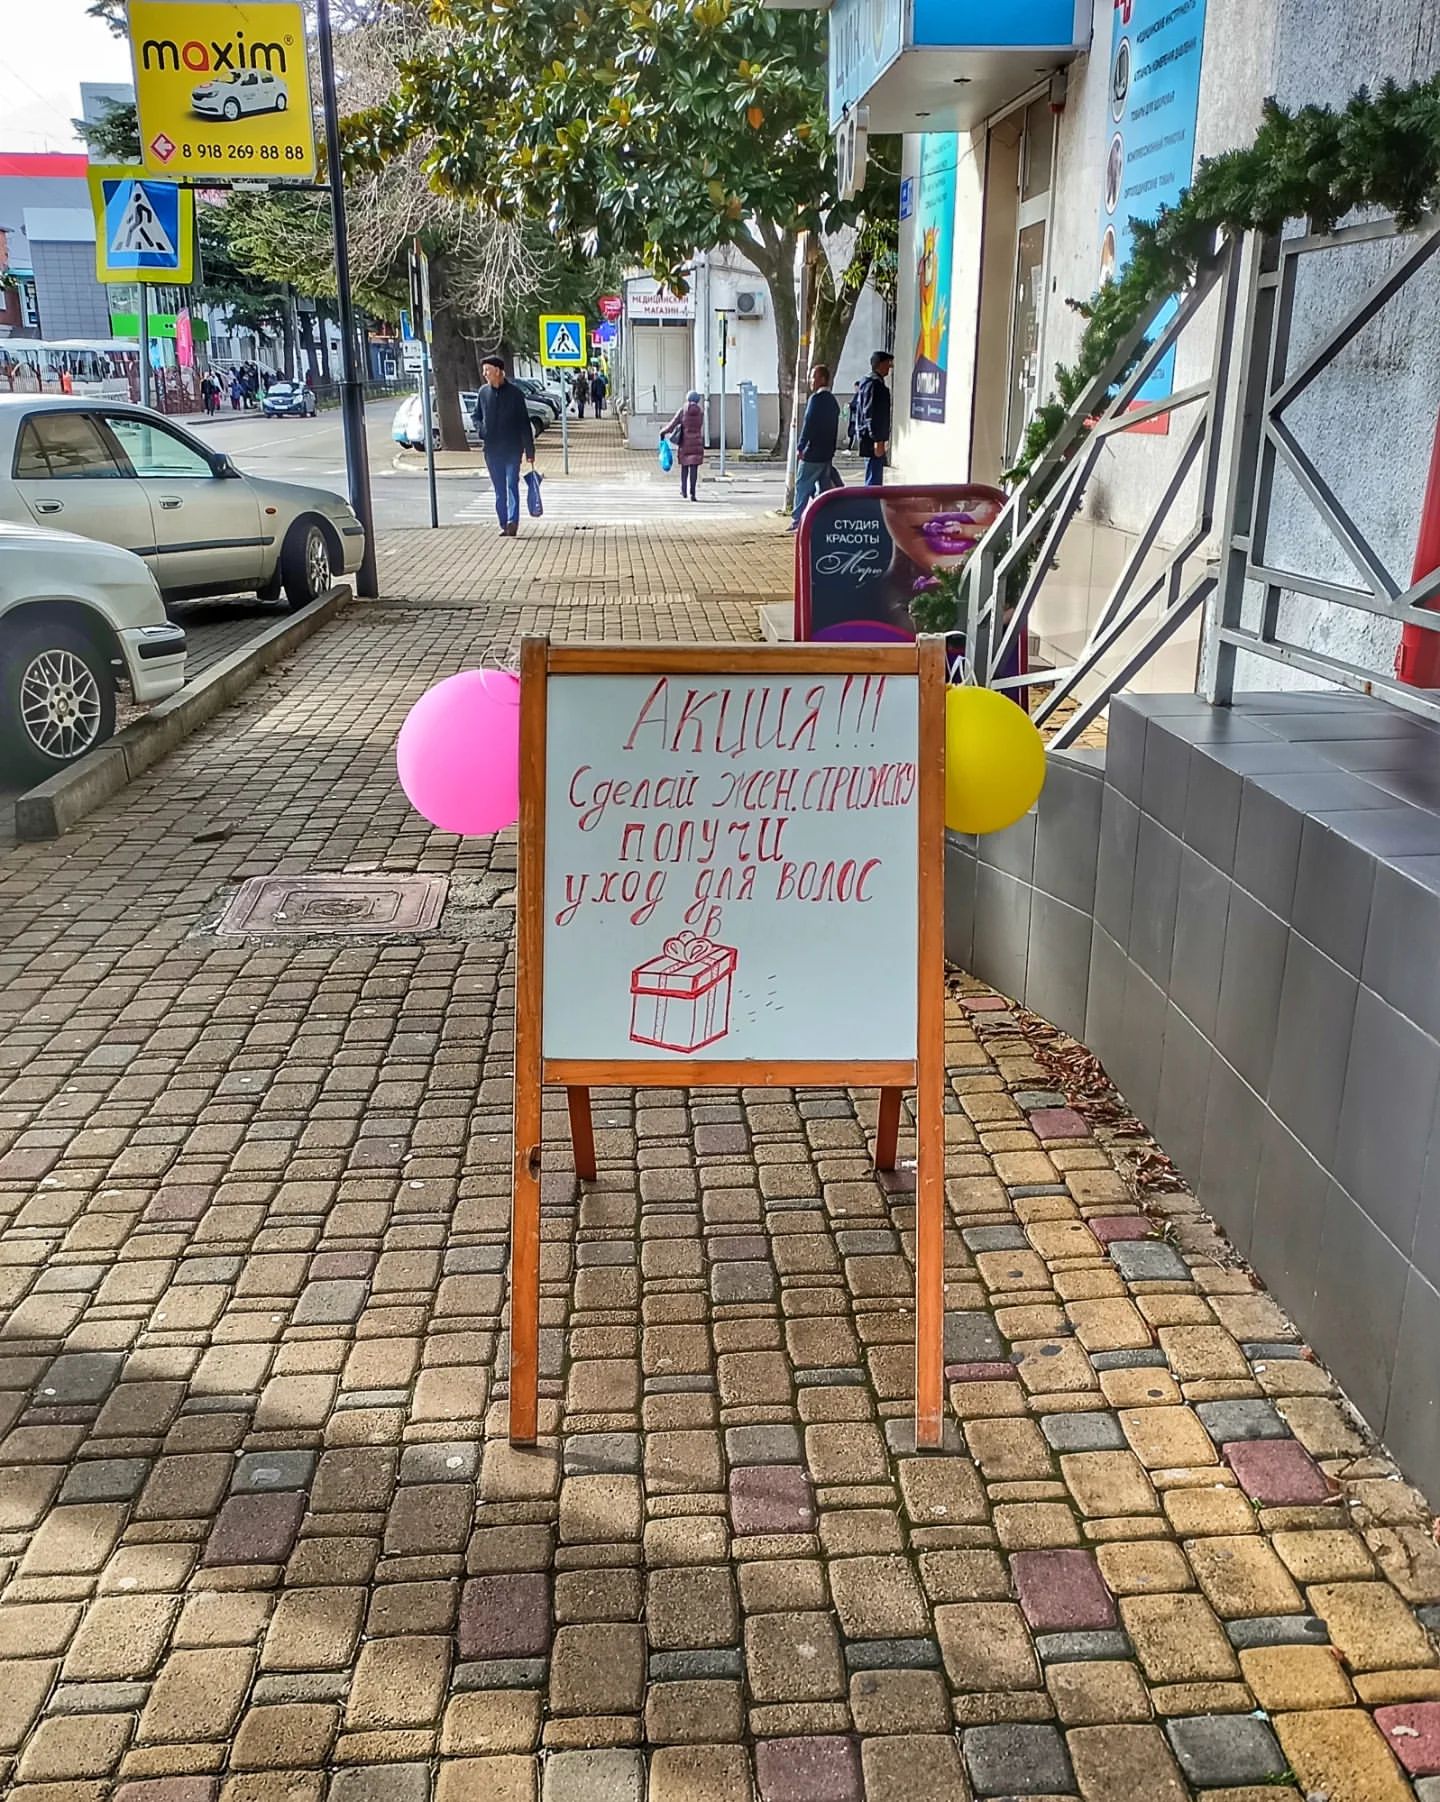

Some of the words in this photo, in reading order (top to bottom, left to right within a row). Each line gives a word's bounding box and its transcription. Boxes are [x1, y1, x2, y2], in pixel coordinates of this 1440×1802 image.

[143, 31, 286, 72] maxim
[183, 144, 192, 158] 8
[197, 144, 222, 158] 918
[228, 145, 254, 159] 269
[260, 145, 279, 160] 88
[285, 146, 304, 160] 88
[644, 305, 679, 316] МАГАЗИН
[834, 519, 880, 531] СТУДИЯ
[825, 533, 880, 544] КРАСОТЫ
[569, 764, 700, 832] Сделай
[554, 870, 668, 927] уход
[684, 864, 757, 925] для
